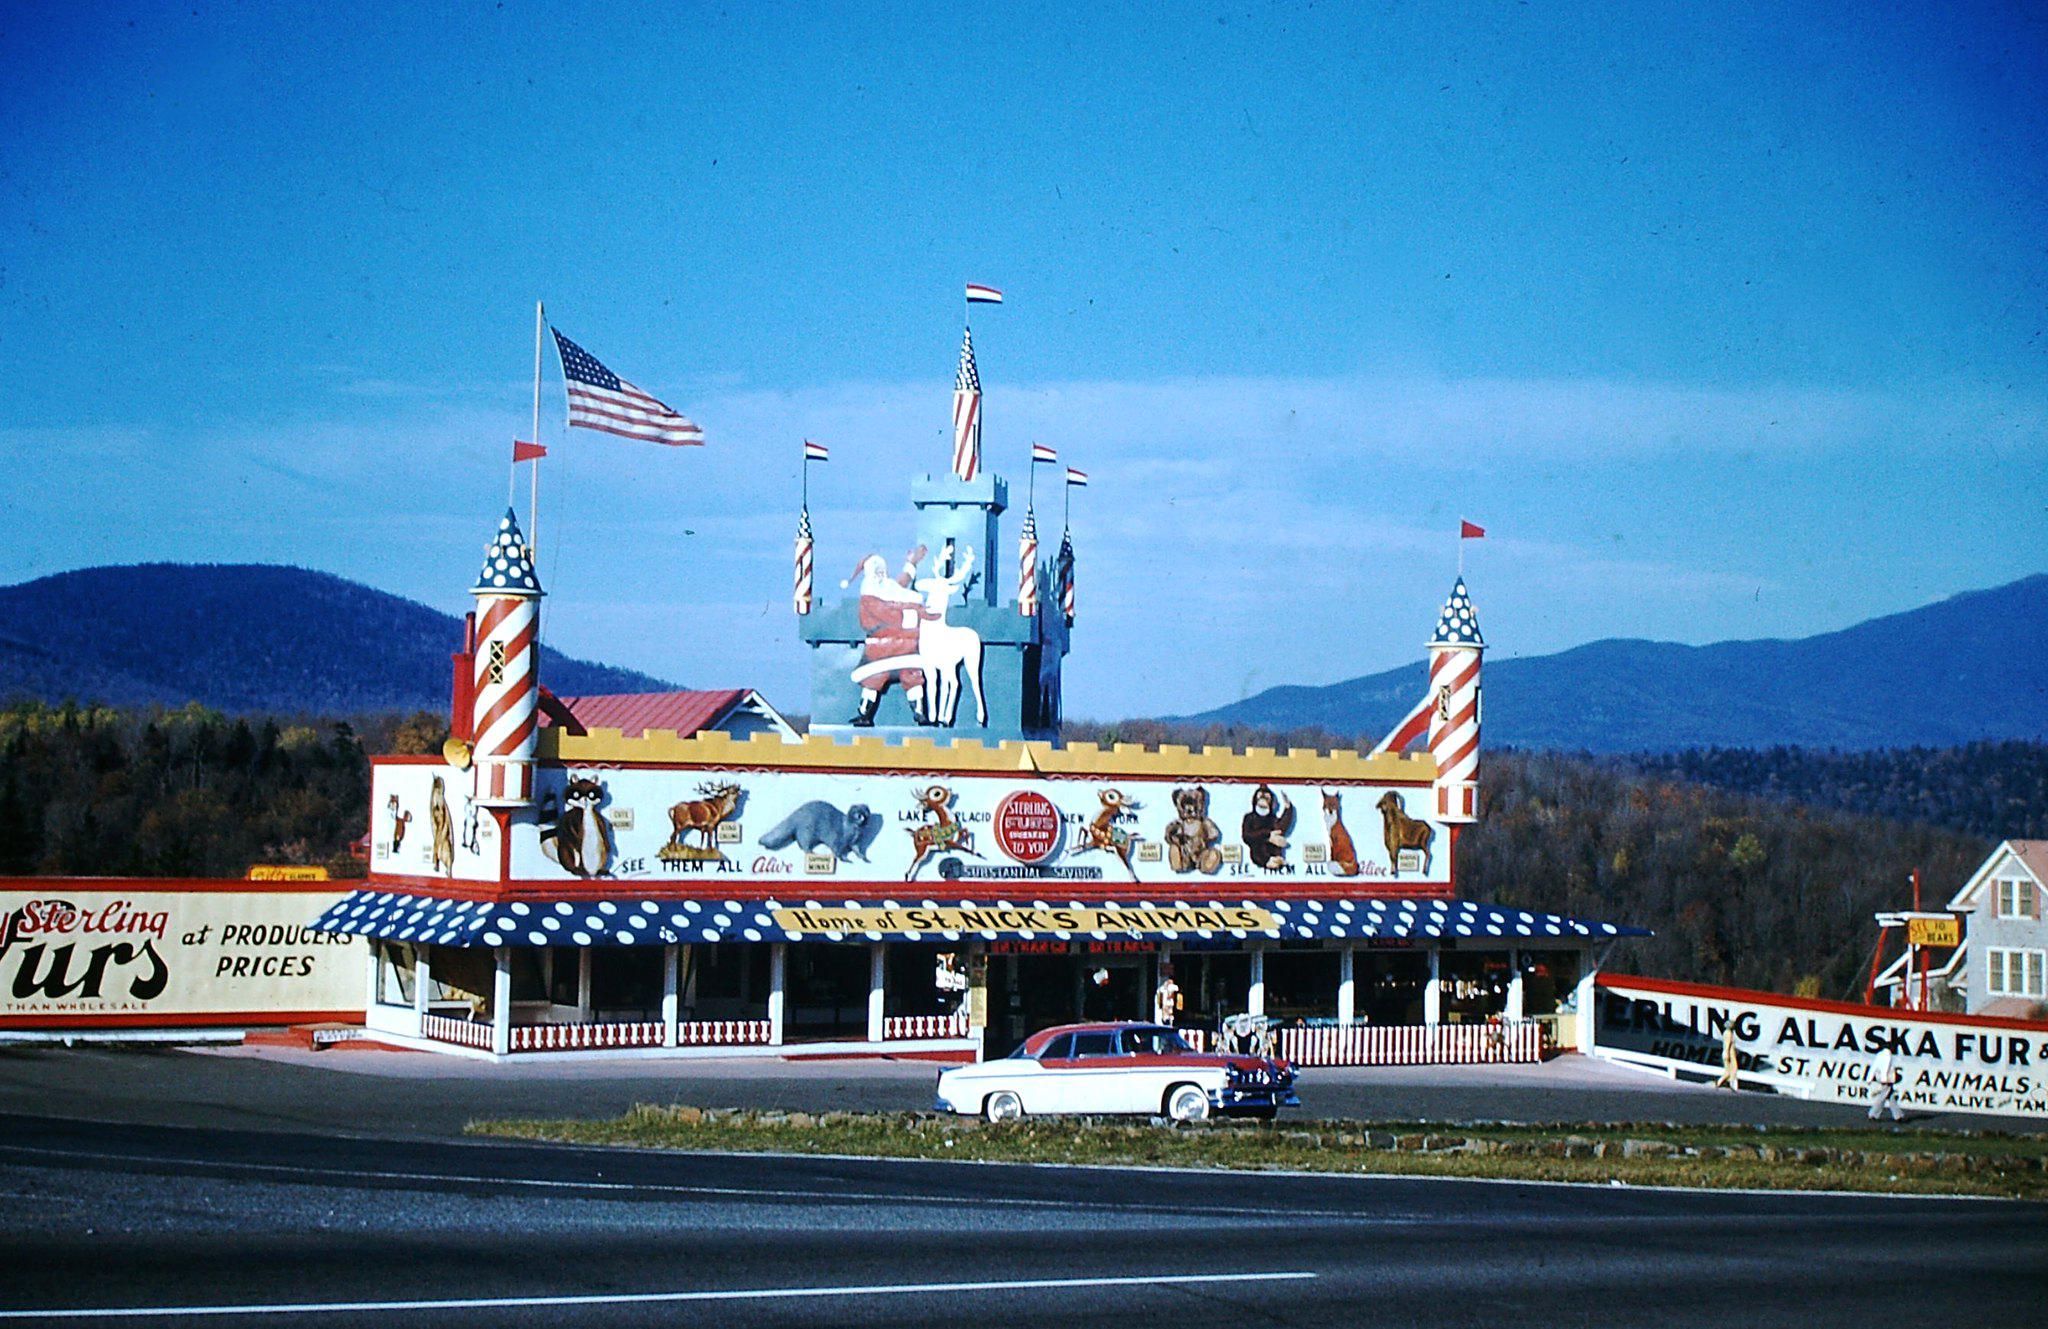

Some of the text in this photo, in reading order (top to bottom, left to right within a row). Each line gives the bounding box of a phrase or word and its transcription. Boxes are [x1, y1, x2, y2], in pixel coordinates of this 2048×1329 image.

[899, 810, 992, 822] LAKE PLACID
[1008, 802, 1050, 815] STERLING
[1005, 816, 1054, 830] FURS
[1061, 813, 1085, 824] NEW
[1013, 842, 1048, 855] TO YOU
[622, 858, 645, 873] SEE
[661, 859, 704, 872] THEM
[717, 860, 743, 873] ALL
[752, 856, 794, 874] Alive
[963, 866, 1102, 878] SUBSTANTIAL SAVINGS
[1230, 863, 1249, 876] SEE
[1263, 863, 1295, 875] THEM
[1305, 864, 1327, 875] ALL
[18, 900, 169, 940] Sterling
[791, 910, 865, 930] Home
[876, 908, 895, 929] of
[1096, 910, 1260, 930] ANIMALS
[181, 924, 353, 946] at PRODUCERS
[215, 955, 315, 978] PRICES
[1776, 1016, 1941, 1060] ALASKA
[1955, 1033, 2030, 1066] FUR
[1652, 1040, 1722, 1067] HOME
[1736, 1050, 1769, 1073] OF
[1778, 1056, 1810, 1077] ST.
[1915, 1070, 2030, 1095] ANIMALS
[1837, 1085, 1869, 1099] FUR
[1945, 1095, 1994, 1109] ALIVE
[2015, 1099, 2048, 1112] TAM
